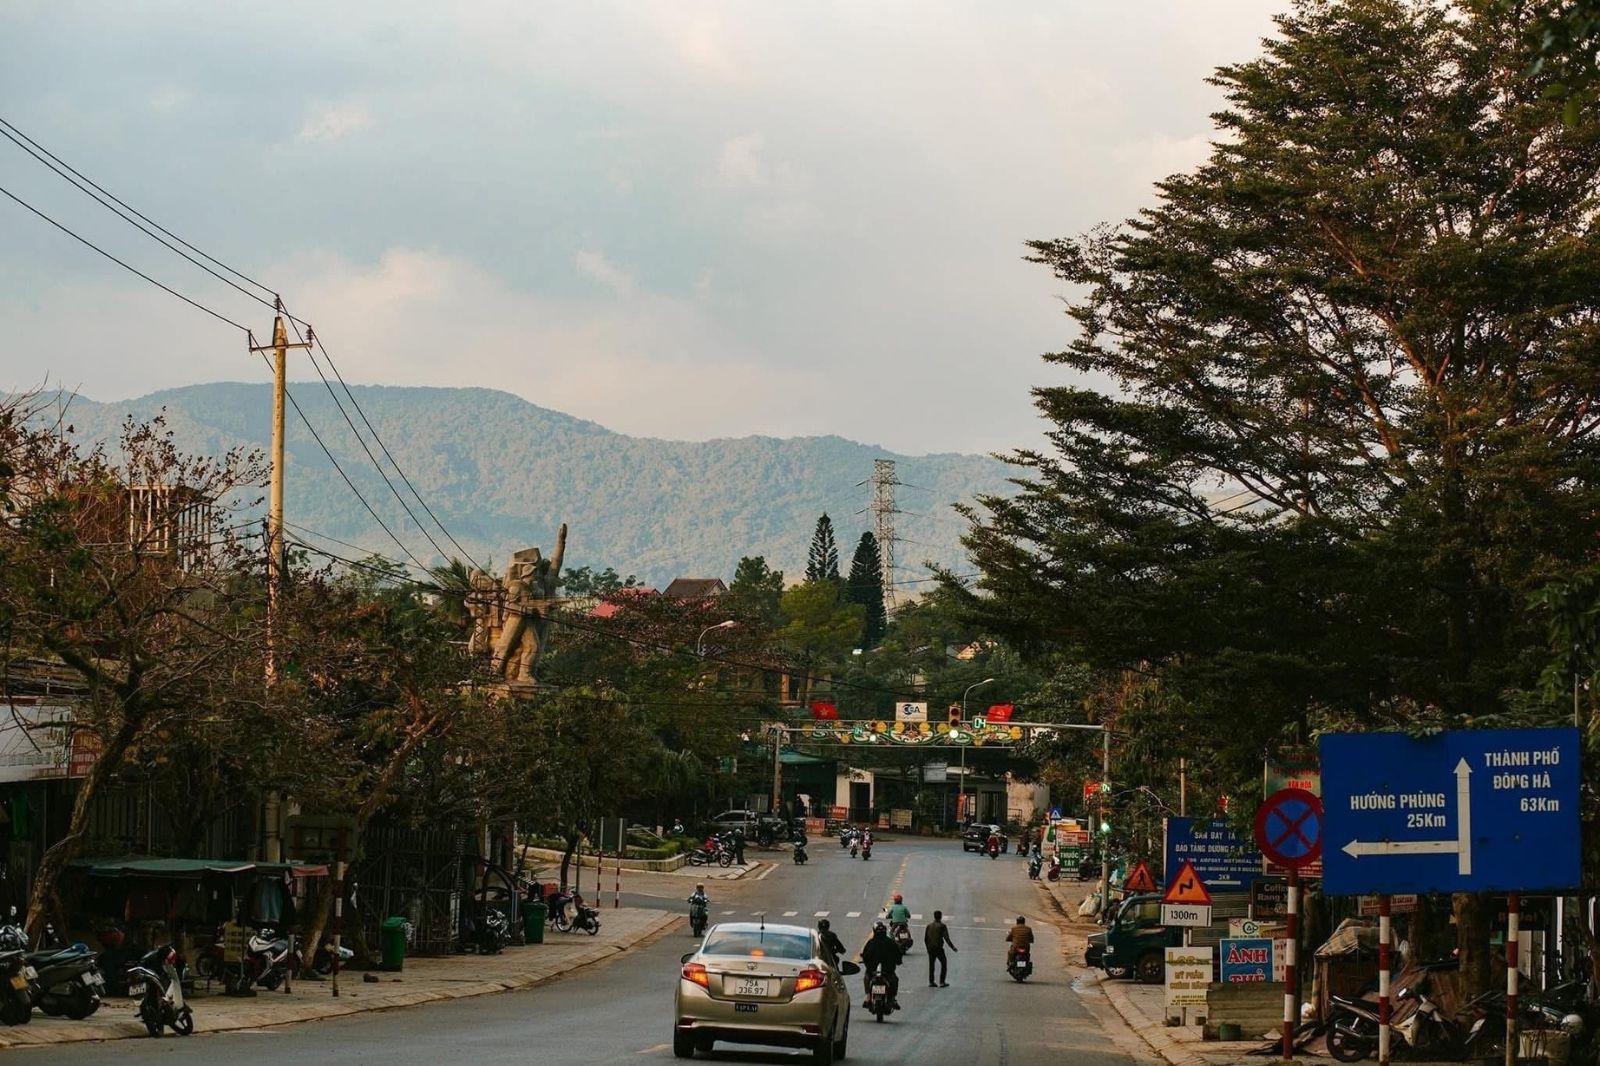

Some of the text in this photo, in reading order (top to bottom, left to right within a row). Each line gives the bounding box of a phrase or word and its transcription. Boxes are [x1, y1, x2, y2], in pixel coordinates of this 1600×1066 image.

[973, 717, 987, 729] 04
[1484, 746, 1560, 767] THÀNH PHỐ
[1493, 771, 1551, 790] ĐÔNG HÀ
[1350, 790, 1445, 810] HƯỚNG PHÙNG
[1520, 797, 1560, 812] 63Km
[1407, 813, 1446, 828] 25Km
[1210, 831, 1223, 840] BAY
[1170, 910, 1198, 920] 1300m
[1227, 943, 1268, 964] ẢNH
[744, 979, 759, 987] 75A
